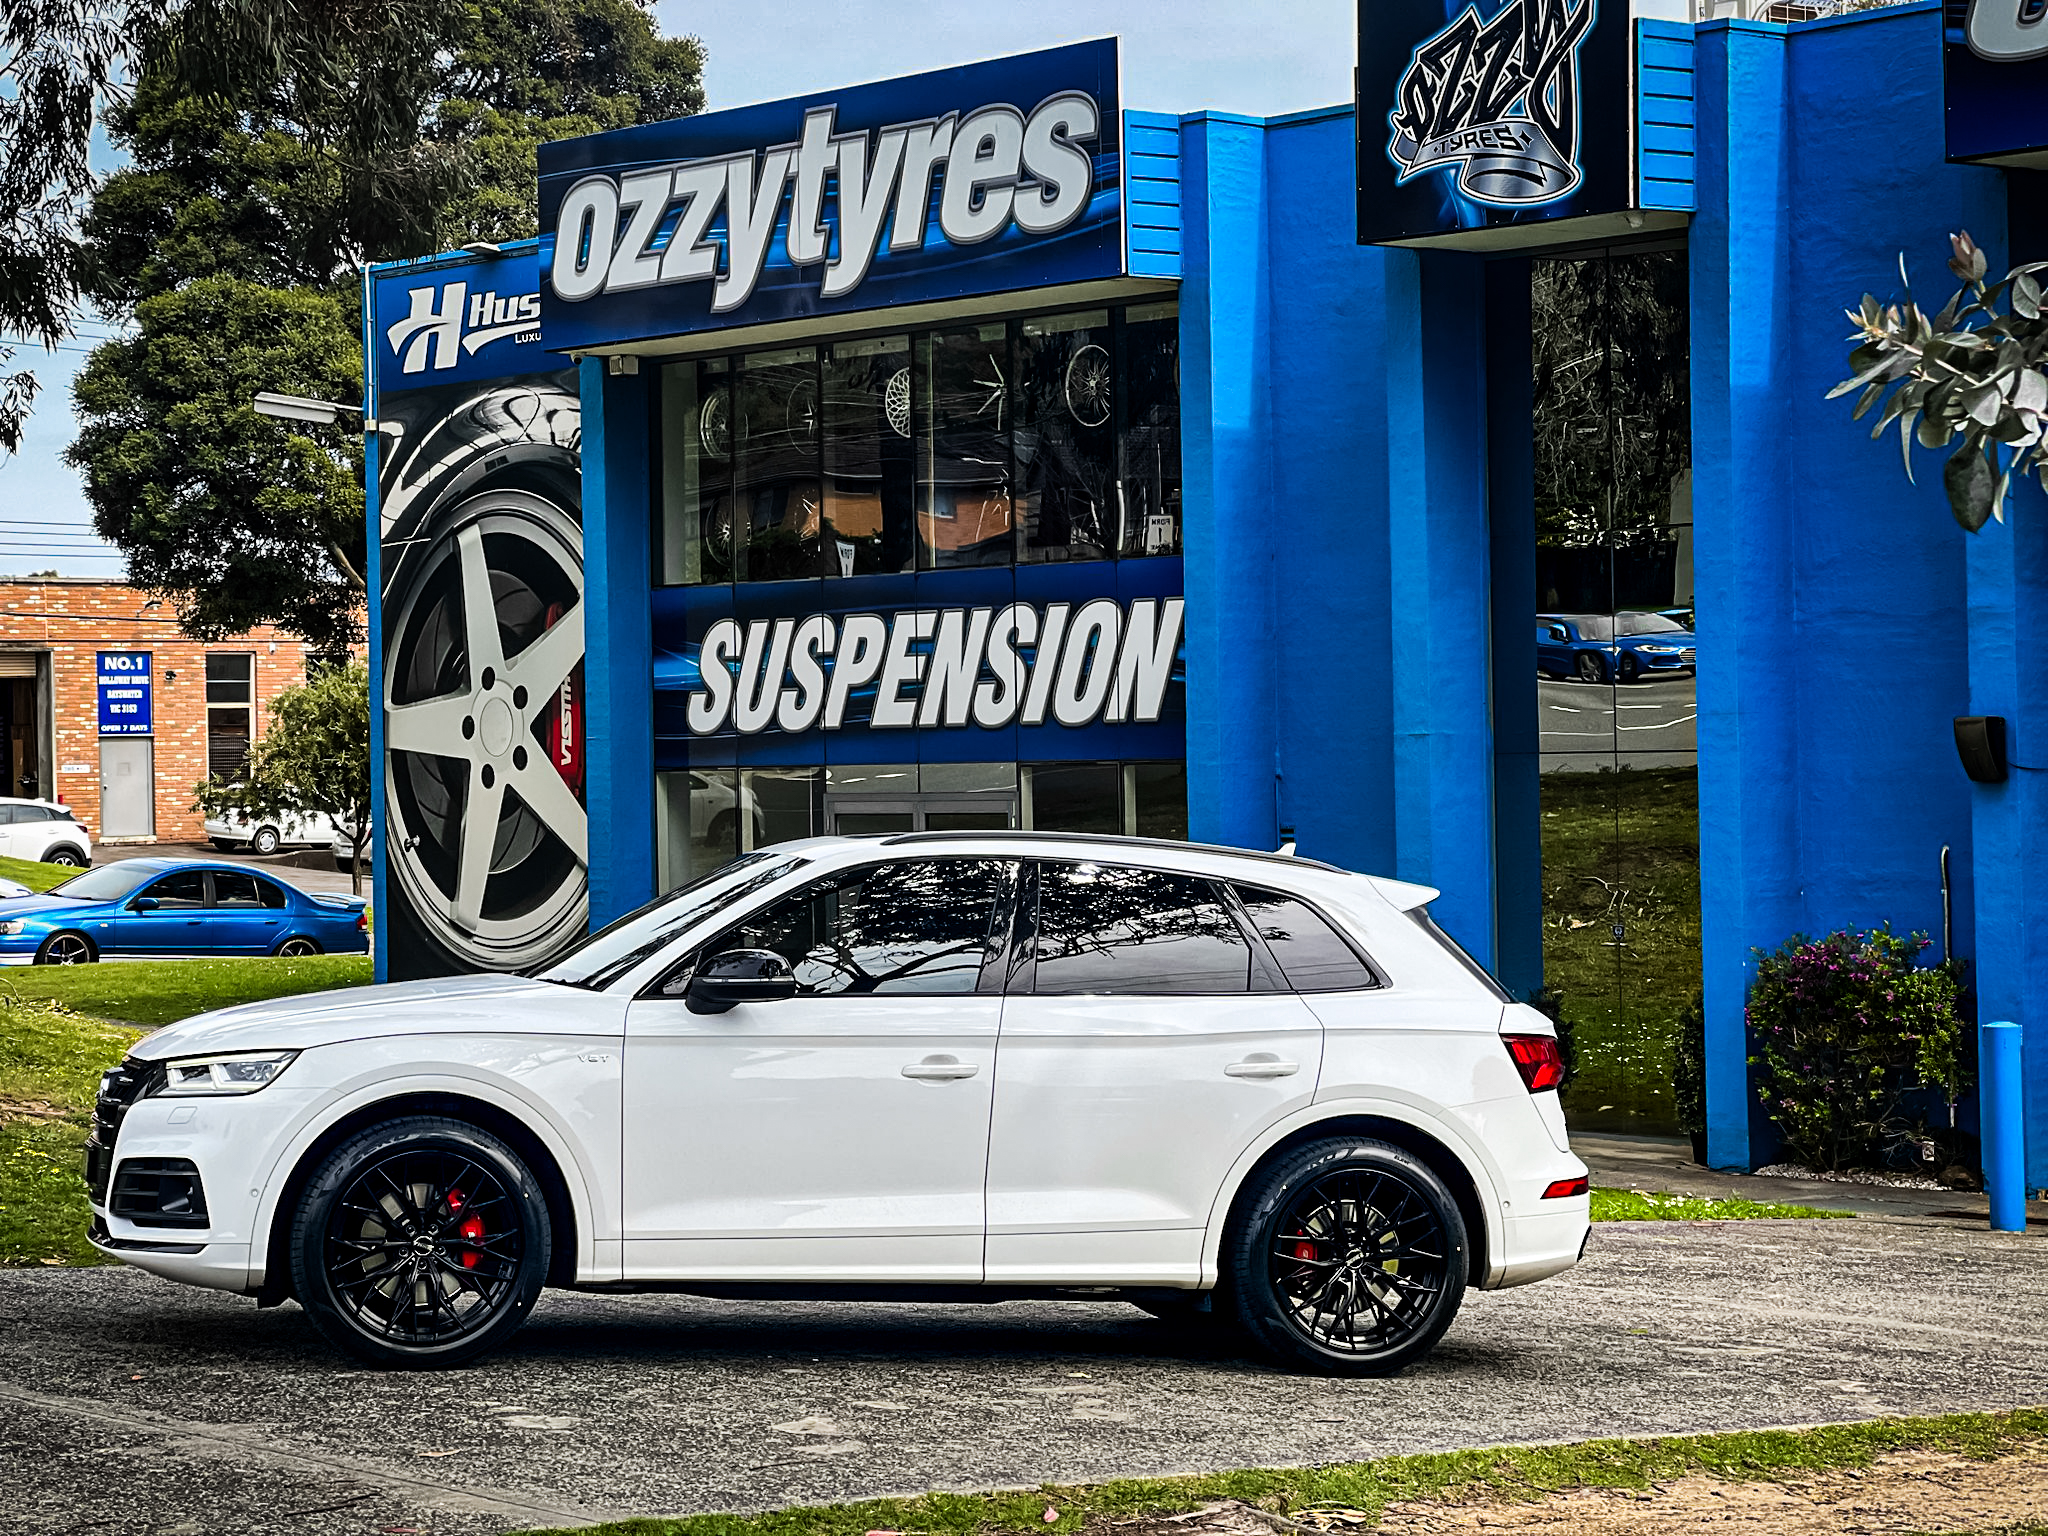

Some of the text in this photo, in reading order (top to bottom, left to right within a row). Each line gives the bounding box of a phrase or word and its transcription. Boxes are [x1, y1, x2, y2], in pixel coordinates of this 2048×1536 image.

[1439, 126, 1525, 152] TYRES
[551, 89, 1099, 313] ozzytyres
[104, 656, 143, 670] NO.1
[686, 597, 1185, 735] SUSPENSION
